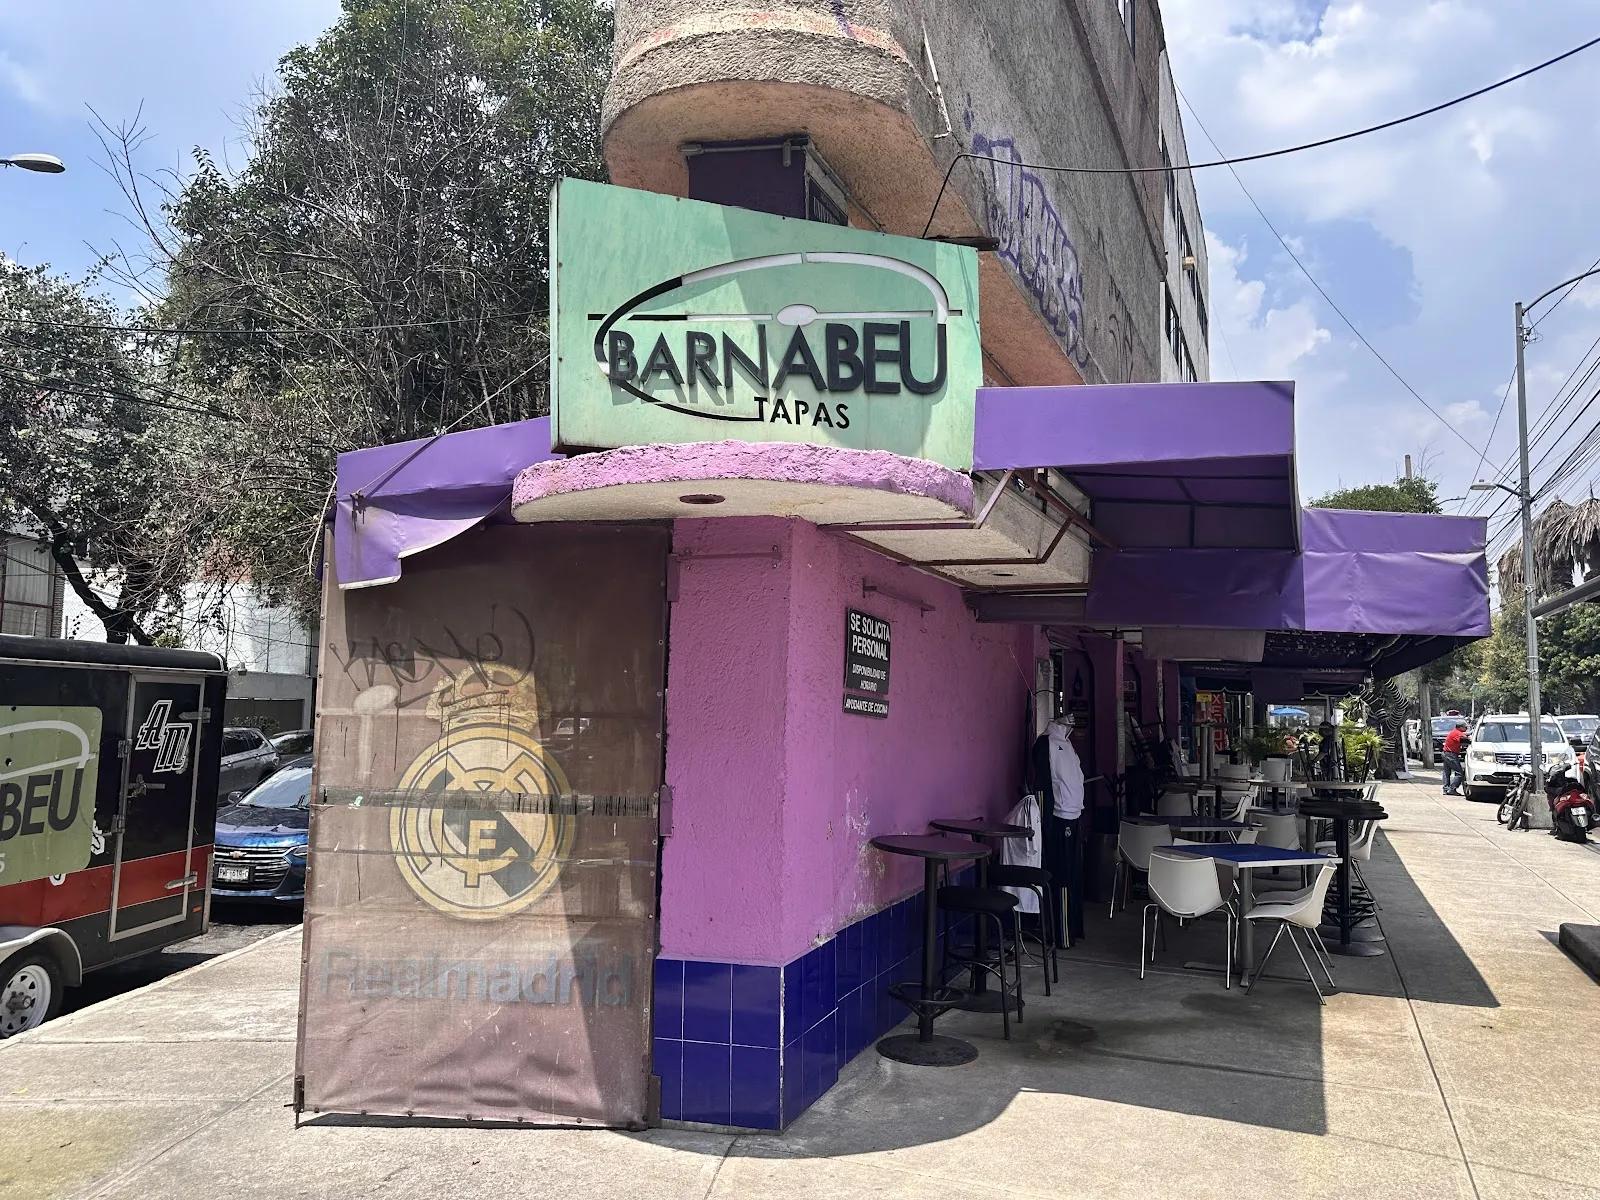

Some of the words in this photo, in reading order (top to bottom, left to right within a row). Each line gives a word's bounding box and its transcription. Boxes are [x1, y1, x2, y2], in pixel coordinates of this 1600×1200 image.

[609, 320, 947, 394] BARNABEU
[754, 396, 850, 430] TAPAS
[850, 612, 861, 633] SE
[862, 616, 890, 642] SOLICITA
[852, 634, 888, 661] PERSONAL
[852, 663, 880, 679] DISPONIBILIDAD
[880, 670, 886, 681] DE
[860, 680, 878, 692] HORARIO
[867, 702, 874, 713] DE
[874, 703, 888, 715] COCINA
